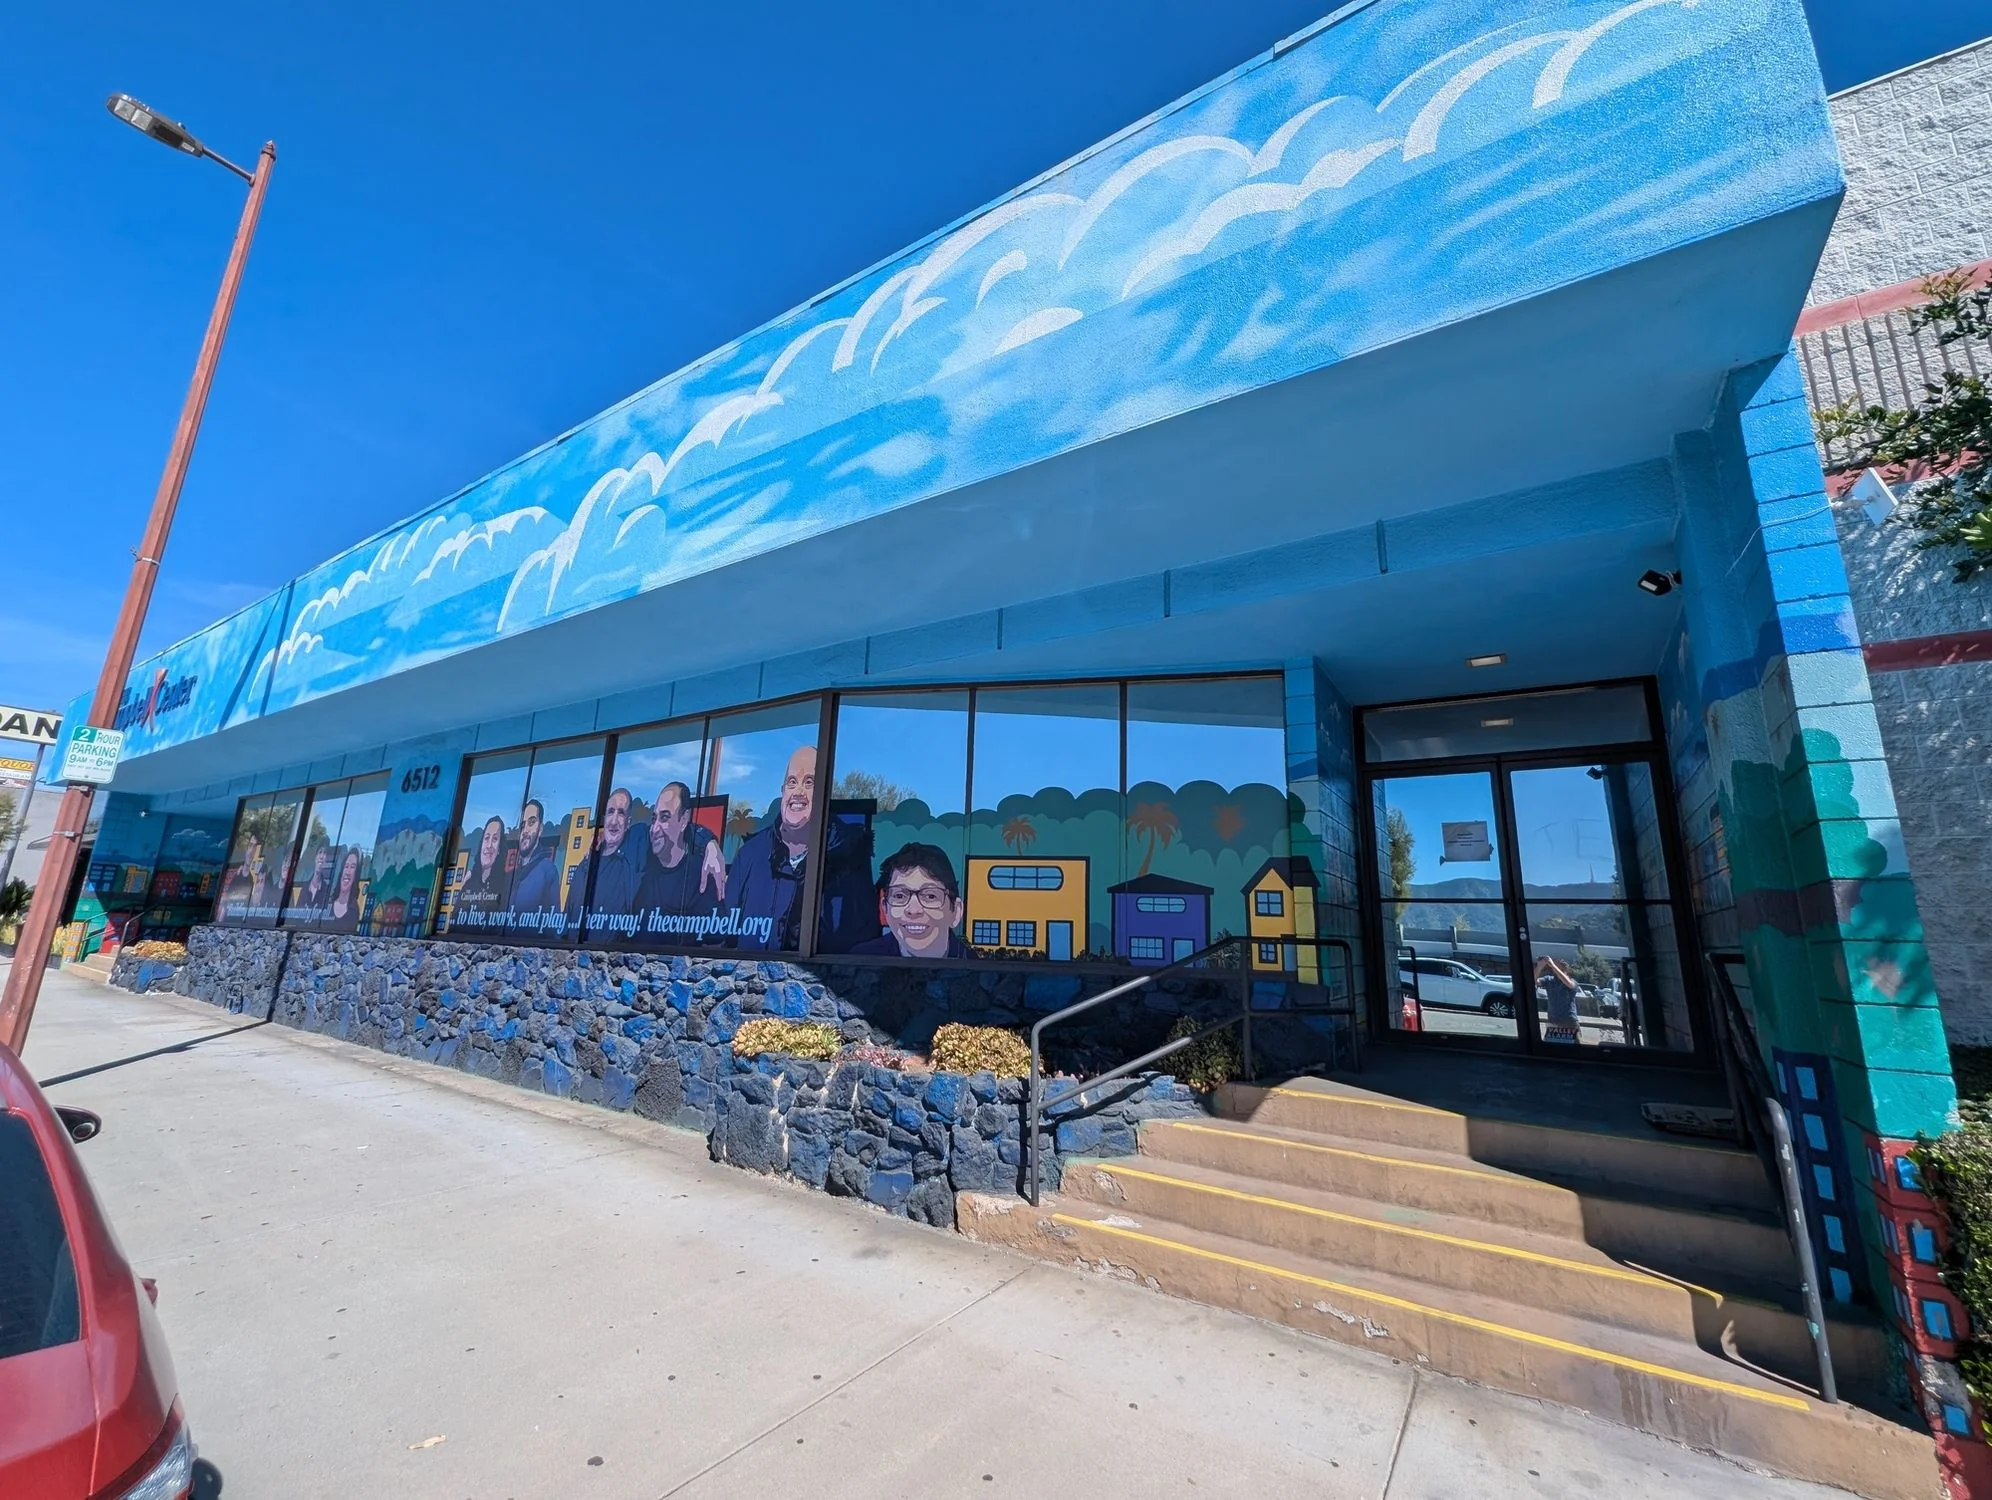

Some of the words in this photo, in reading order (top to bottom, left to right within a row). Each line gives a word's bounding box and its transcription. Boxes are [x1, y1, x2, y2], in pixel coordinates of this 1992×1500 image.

[0, 712, 62, 740] AN
[79, 728, 91, 741] 2
[97, 732, 120, 746] HOUR
[71, 742, 117, 759] PARKING
[0, 759, 34, 770] QUO
[69, 754, 88, 763] 9AM
[96, 757, 114, 767] 6PM
[401, 764, 440, 794] 6512
[488, 905, 516, 931] work,
[647, 906, 773, 944] thecampbell.org
